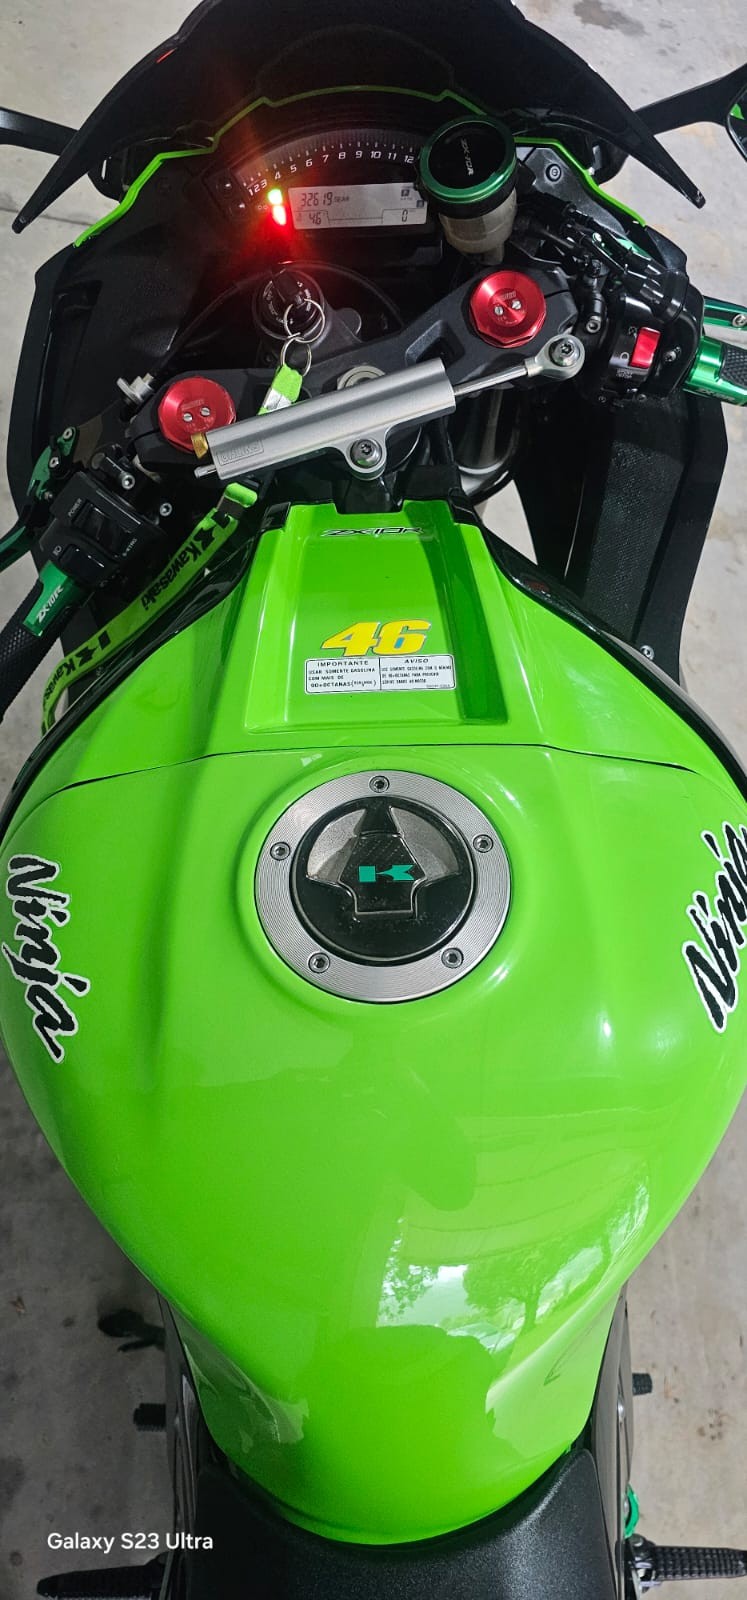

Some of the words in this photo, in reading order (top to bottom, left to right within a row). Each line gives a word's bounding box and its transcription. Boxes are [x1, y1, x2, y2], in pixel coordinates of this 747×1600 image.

[248, 188, 254, 196] 1
[261, 179, 268, 188] 3
[274, 171, 281, 180] 4
[290, 164, 297, 173] 5
[305, 158, 313, 167] 6
[322, 154, 329, 163] 7
[338, 151, 346, 160] 8
[355, 150, 363, 159] 9
[370, 150, 382, 159] 10
[387, 152, 397, 161] 11
[404, 155, 415, 164] 12
[301, 191, 333, 207] 32619
[141, 541, 202, 611] Kawasaki
[320, 619, 432, 657] 46
[3, 855, 90, 1062] Ninja
